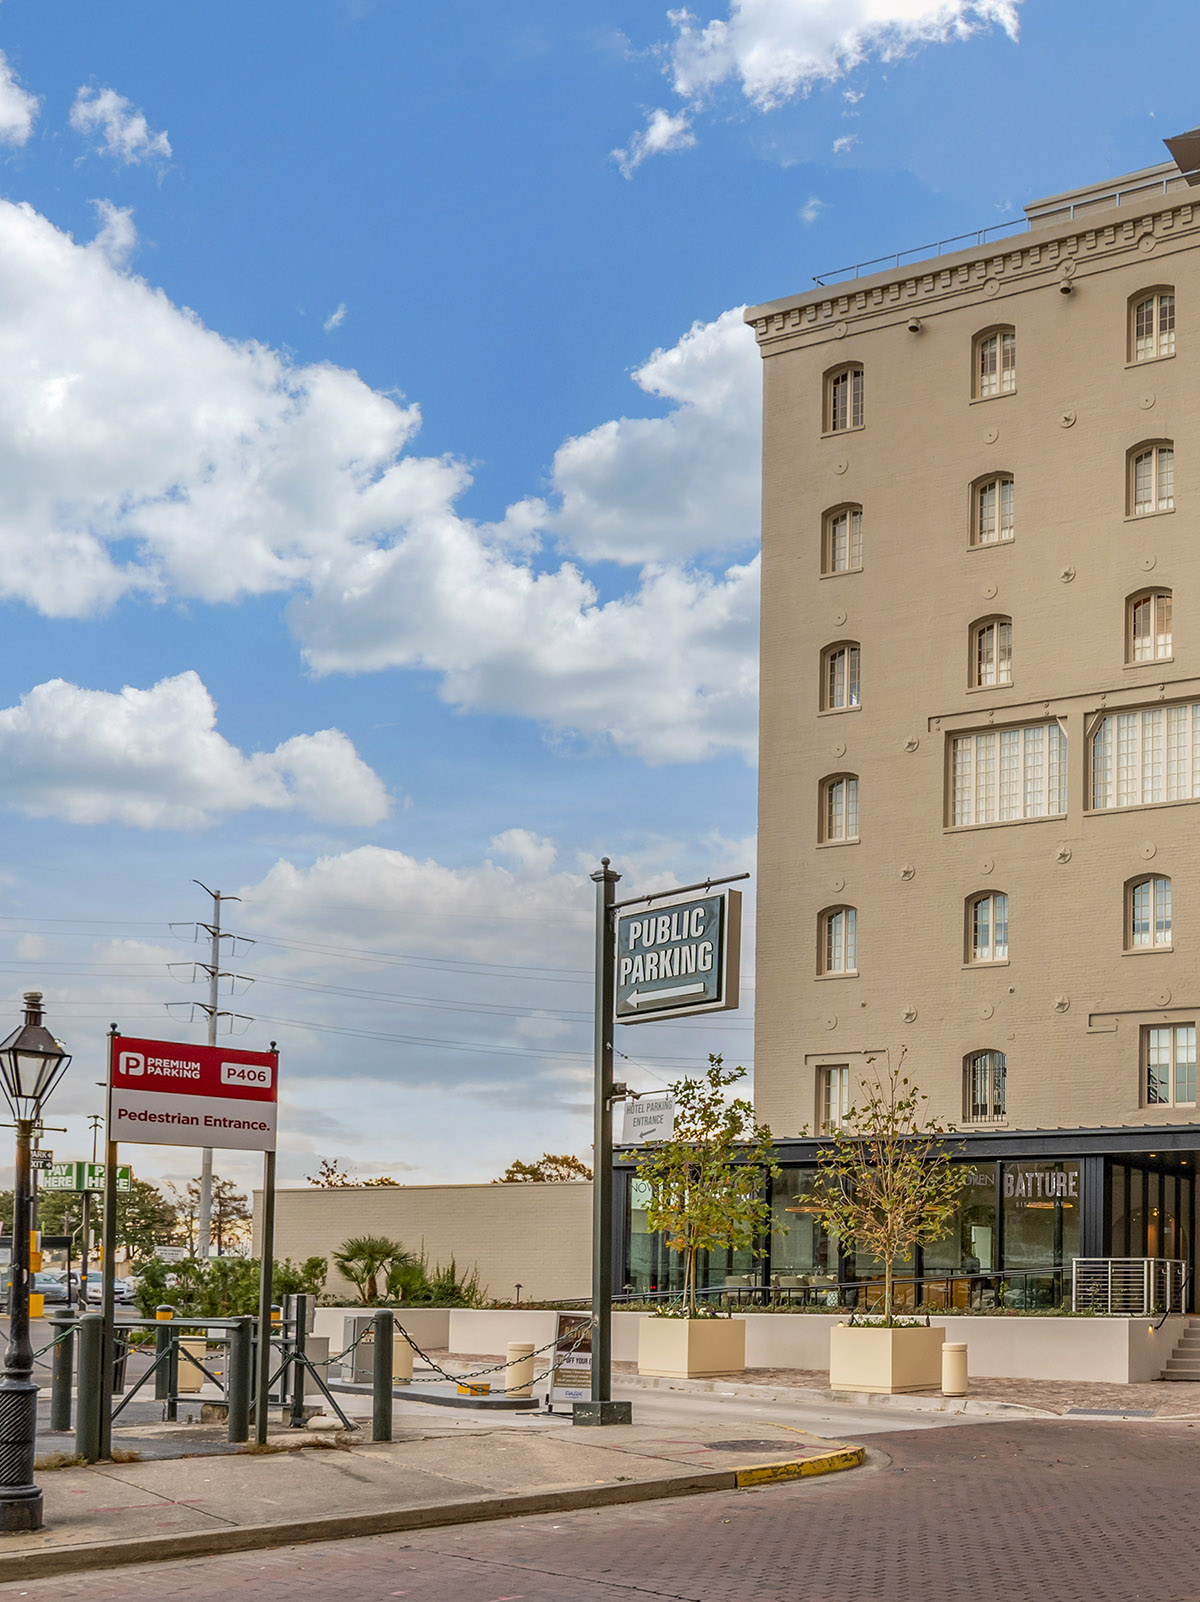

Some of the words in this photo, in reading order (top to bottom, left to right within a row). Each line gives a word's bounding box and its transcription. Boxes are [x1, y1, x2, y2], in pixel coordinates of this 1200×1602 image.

[629, 907, 705, 950] PUBLIC
[620, 941, 712, 986] PARKING
[147, 1057, 200, 1070] PREMIUM
[147, 1066, 200, 1079] PARKING
[227, 1068, 266, 1082] P406
[626, 1103, 645, 1114] HOTEL
[646, 1099, 673, 1113] PARKING
[118, 1108, 199, 1126] Pedestrian
[204, 1115, 270, 1131] Entrance.
[633, 1114, 665, 1127] ENTRANCE
[30, 1160, 44, 1168] XIT
[48, 1165, 69, 1176] PAY
[44, 1176, 73, 1188] HERE
[1004, 1171, 1078, 1197] BATTURE
